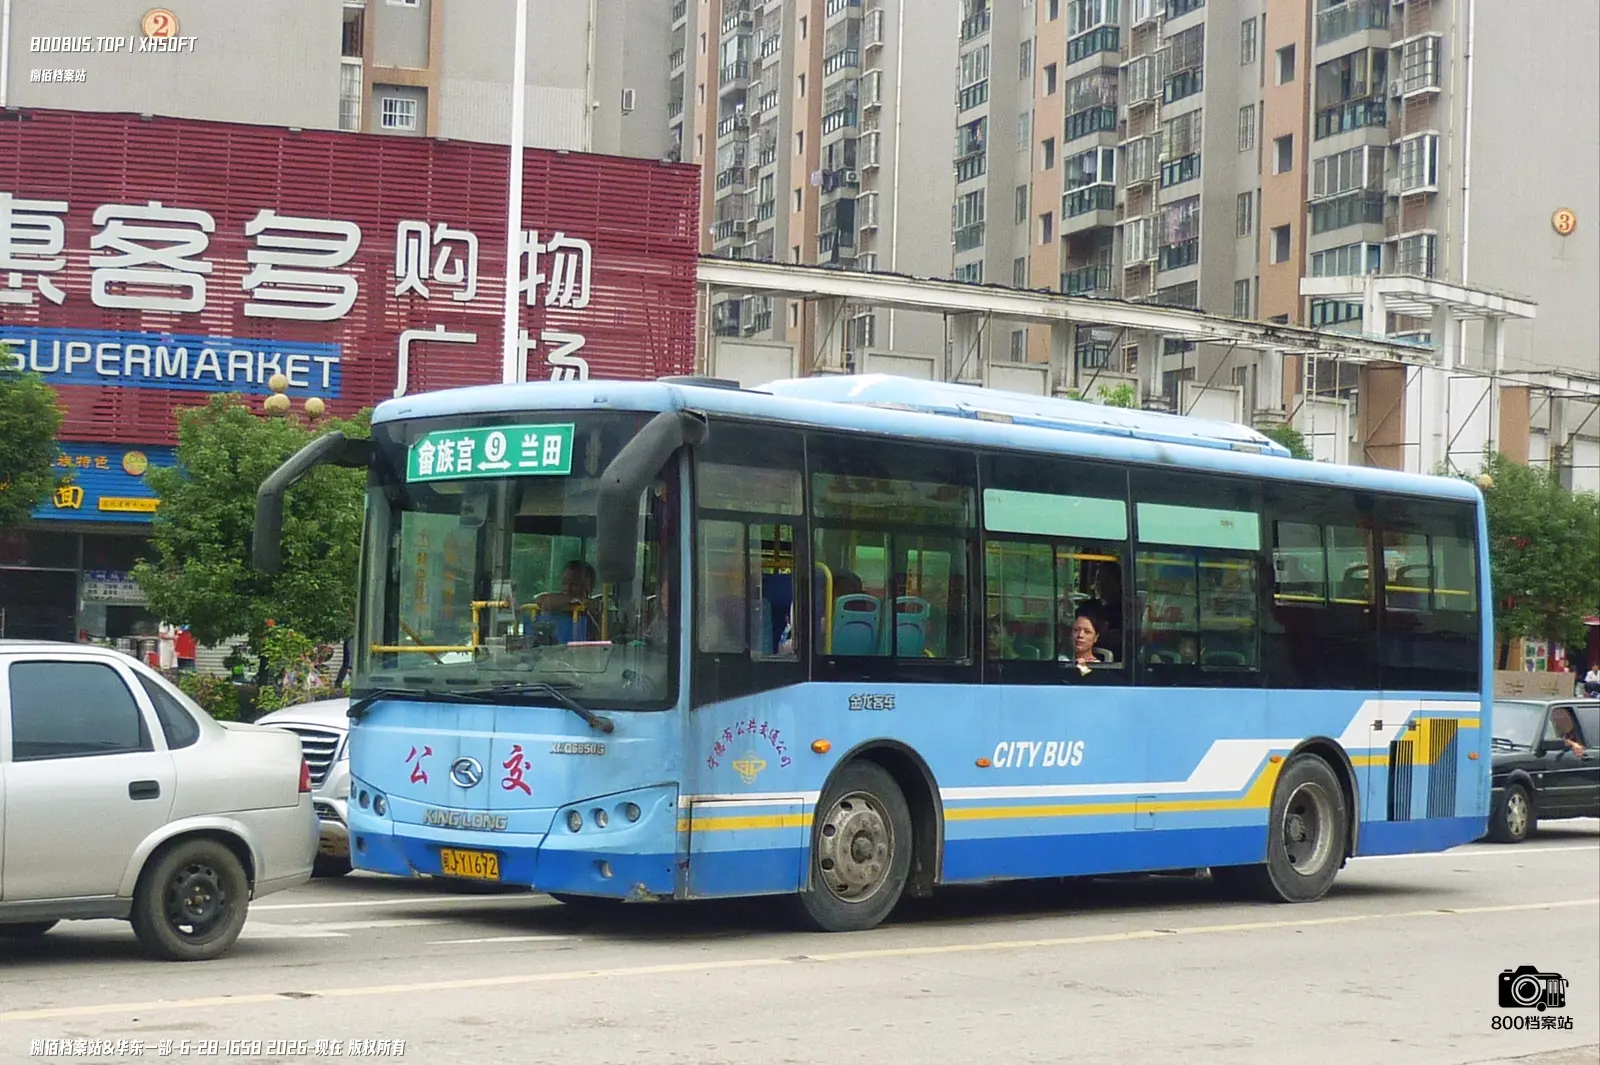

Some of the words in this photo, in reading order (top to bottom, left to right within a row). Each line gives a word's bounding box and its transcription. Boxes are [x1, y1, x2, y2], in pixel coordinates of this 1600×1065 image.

[153, 15, 169, 37] 2
[394, 220, 592, 309] 购物
[0, 338, 340, 389] SUPERMARKET
[393, 324, 589, 398] 广场
[518, 433, 562, 467] 兰田
[848, 693, 896, 711] 金龙客车
[993, 741, 1042, 768] CITY
[1042, 740, 1085, 767] BUS
[423, 807, 460, 827] KING
[462, 811, 508, 832] LONG
